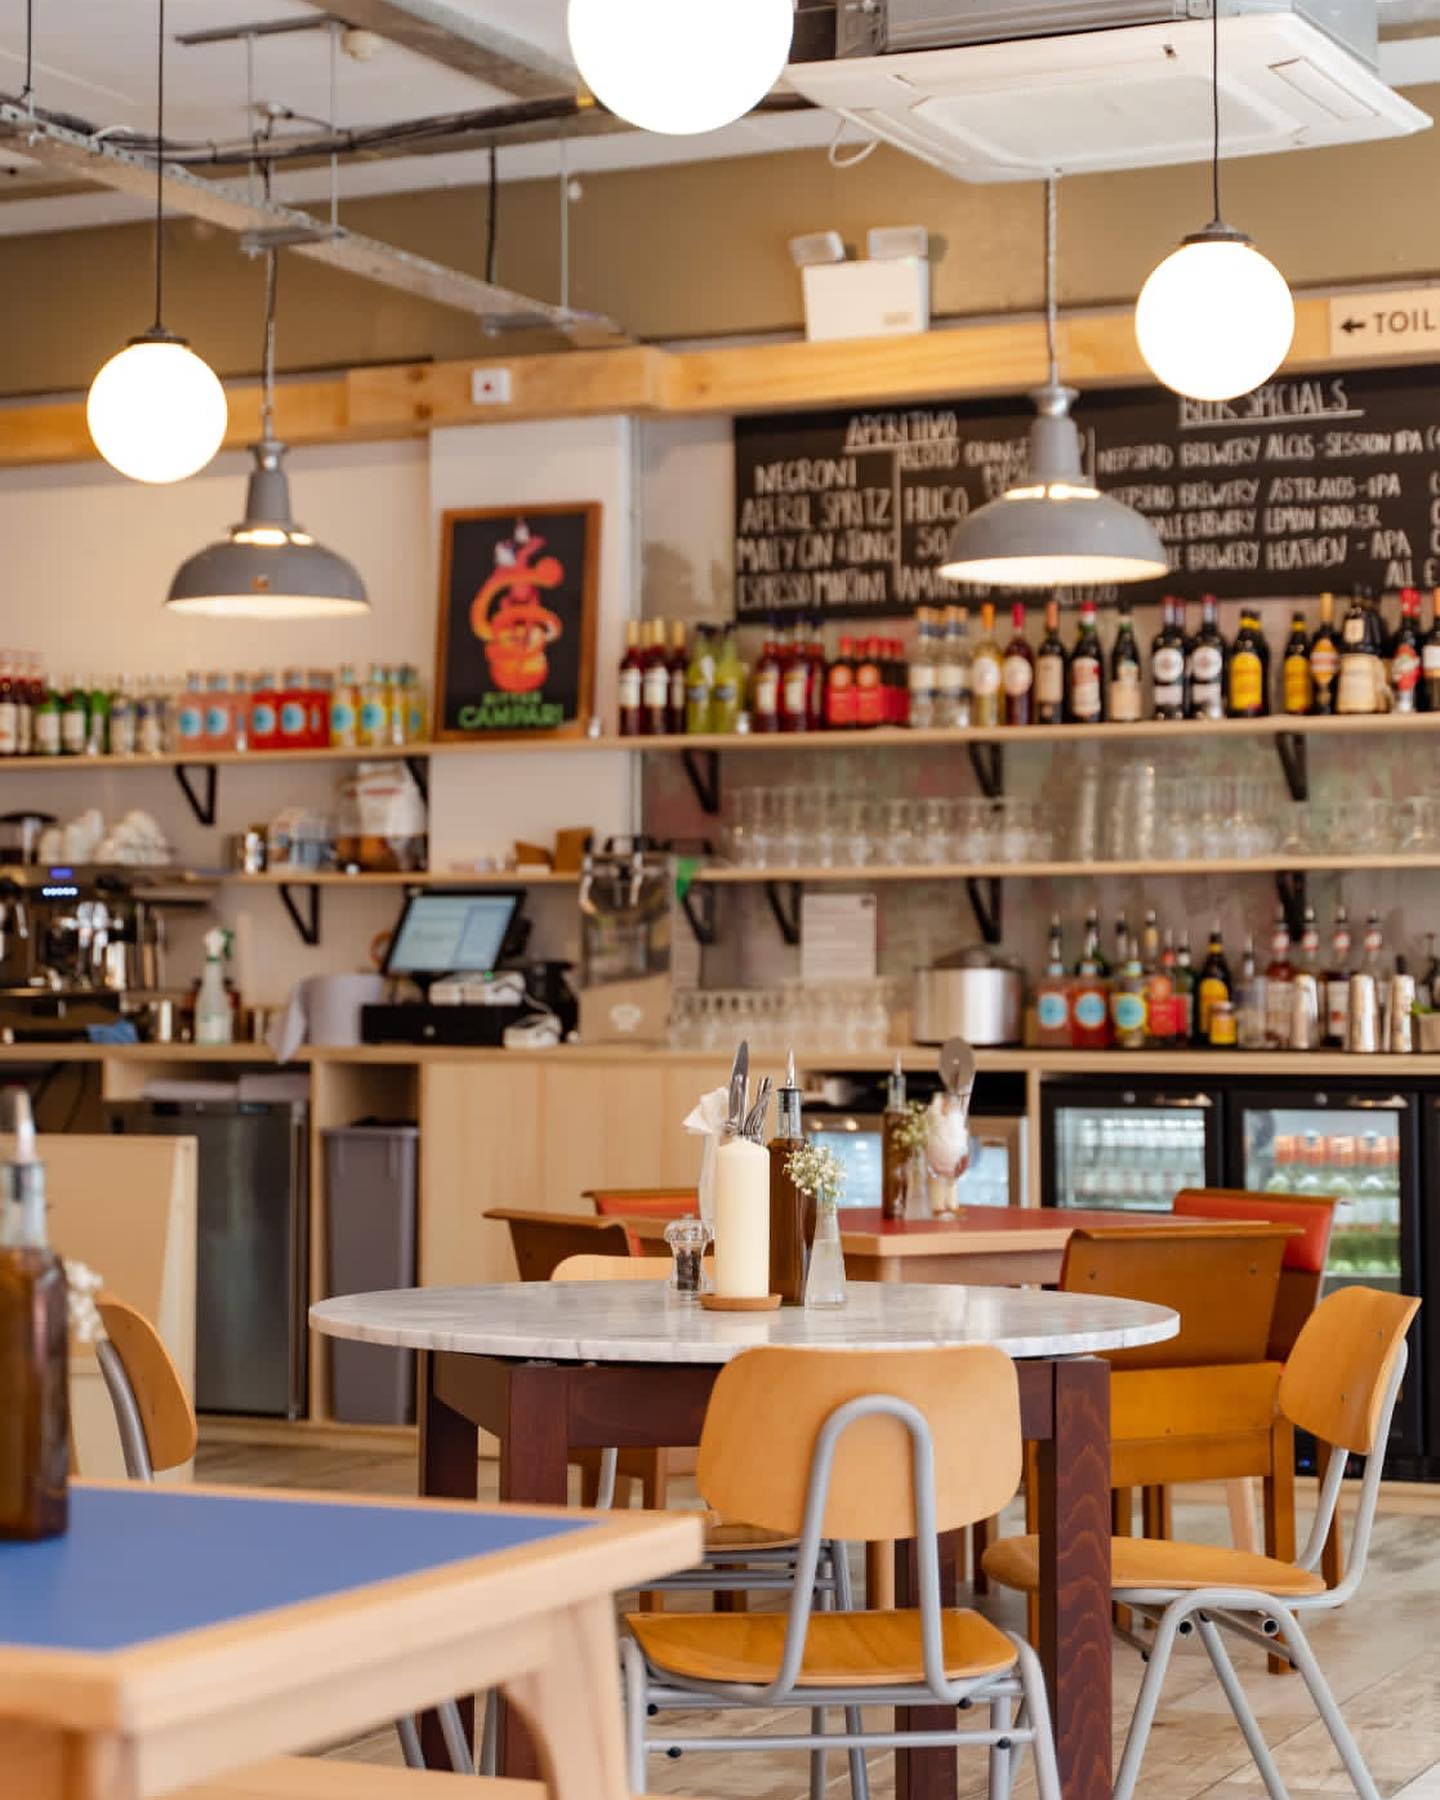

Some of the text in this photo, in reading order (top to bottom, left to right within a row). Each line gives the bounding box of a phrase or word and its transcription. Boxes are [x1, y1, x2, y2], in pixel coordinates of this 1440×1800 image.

[1373, 308, 1437, 335] TOIL
[847, 410, 958, 446] APERITIVO
[1179, 436, 1261, 468] BREWERY
[1325, 431, 1392, 458] SESSION
[1393, 429, 1424, 454] IPA
[754, 458, 857, 496] NEGRONI
[1179, 479, 1260, 509] BREWERY
[1367, 472, 1401, 499] IPA
[740, 487, 892, 536] APEROL SPRITZ
[1186, 508, 1258, 540] BREWERY
[1263, 506, 1316, 535] LEMON
[1318, 503, 1382, 531] RADLER
[1187, 540, 1261, 571] BREWERY
[1265, 536, 1348, 571] HEATHEN
[1370, 529, 1412, 560] APA
[736, 567, 887, 611] ESPRESSO MARTINI
[1385, 559, 1414, 588] ALL
